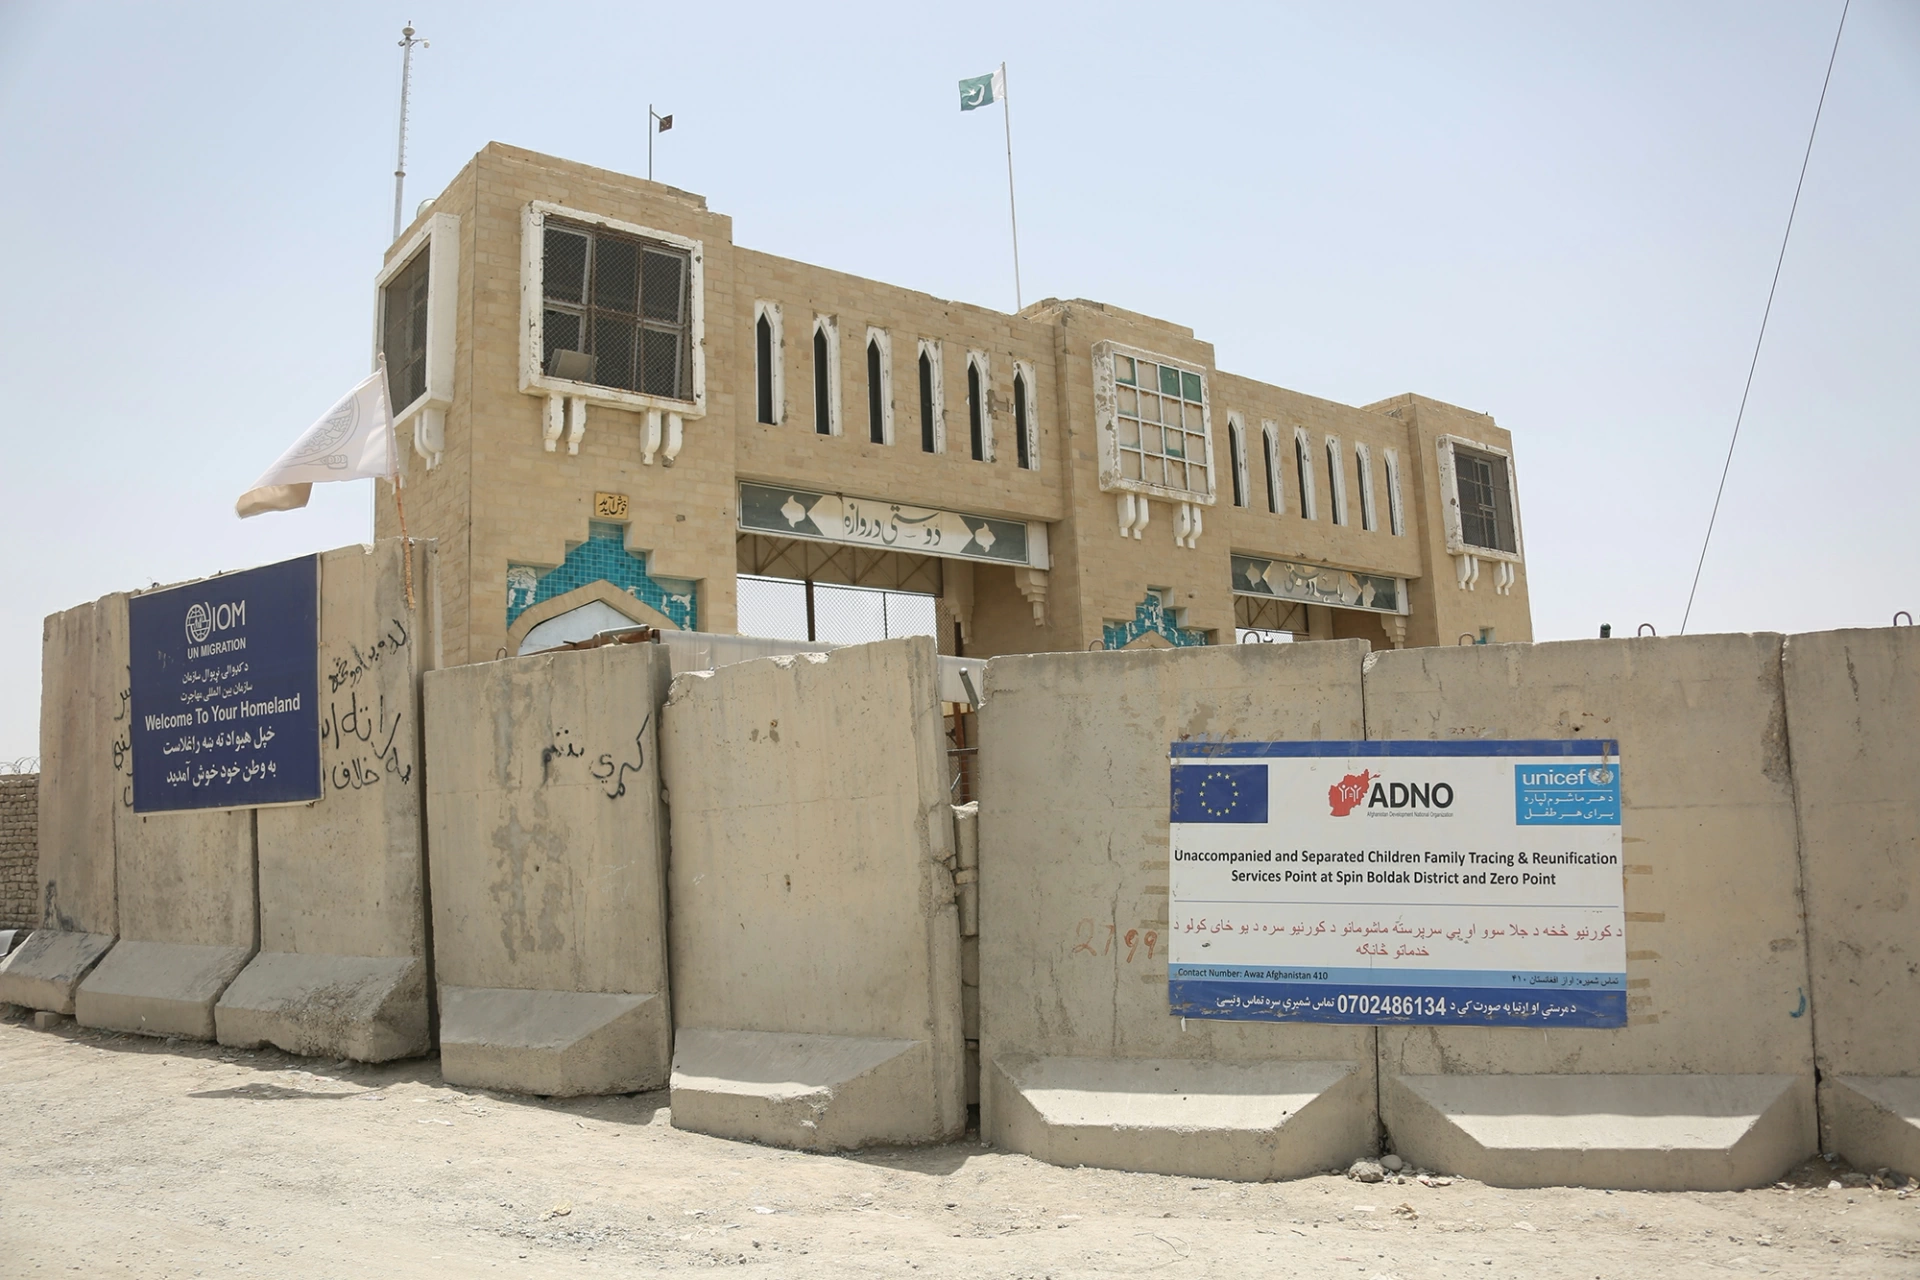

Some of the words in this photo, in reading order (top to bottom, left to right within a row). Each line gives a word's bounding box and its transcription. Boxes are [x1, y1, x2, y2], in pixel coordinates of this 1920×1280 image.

[843, 502, 881, 539] دروازه
[212, 600, 246, 632] IOM
[187, 645, 199, 660] UN
[201, 637, 247, 657] MIGRATION
[144, 712, 193, 732] Welcome
[195, 707, 210, 724] To
[211, 704, 238, 722] Your
[240, 692, 301, 719] Homeland
[215, 732, 225, 748] ته
[253, 725, 276, 750] خپل
[166, 760, 191, 787] آمدید
[192, 763, 219, 788] خوش
[220, 761, 241, 785] خود
[242, 759, 267, 783] وطن
[267, 759, 277, 778] به
[1522, 768, 1587, 786] unicef
[1367, 782, 1455, 809] ADNO
[1523, 792, 1548, 807] لپاره
[1547, 792, 1585, 807] ماشوم
[1586, 794, 1606, 805] هر
[1524, 807, 1557, 820] طفل
[1558, 809, 1583, 820] هر
[1583, 808, 1615, 820] برای
[1174, 849, 1272, 865] Unaccompanied
[1275, 850, 1299, 862] and
[1301, 850, 1364, 865] Separated
[1367, 850, 1421, 863] Children
[1424, 851, 1466, 867] Family
[1469, 851, 1515, 867] Tracing
[1518, 852, 1529, 865] &
[1532, 852, 1618, 866] Reunification
[1231, 869, 1282, 883] Services
[1284, 870, 1318, 883] Point
[1320, 871, 1333, 883] at
[1336, 870, 1364, 886] Spin
[1366, 870, 1411, 884] Boldak
[1414, 871, 1460, 885] District
[1462, 872, 1487, 885] and
[1489, 872, 1519, 885] Zero
[1522, 873, 1557, 885] Point
[1173, 920, 1180, 931] د
[1183, 917, 1207, 934] کولو
[1238, 923, 1250, 935] یو
[1252, 922, 1259, 932] د
[1262, 923, 1285, 936] سره
[1289, 920, 1326, 936] کورنیو
[1330, 923, 1337, 933] د
[1340, 921, 1389, 937] ماشومانو
[1464, 922, 1476, 939] او
[1508, 923, 1529, 939] جلا
[1533, 927, 1540, 937] د
[1542, 923, 1569, 938] څخه
[1573, 924, 1612, 941] کورنیو
[1616, 928, 1623, 938] د
[1393, 943, 1430, 959] خدماتو
[1177, 967, 1207, 977] Contact
[1208, 969, 1242, 978] Number:
[1243, 970, 1264, 979] Awaz
[1266, 970, 1311, 980] Afghanistan
[1312, 971, 1328, 980] 410
[1600, 976, 1619, 987] تماس
[1242, 995, 1265, 1009] تماس
[1264, 998, 1281, 1009] سره
[1312, 997, 1335, 1011] تماس
[1337, 994, 1447, 1016] 0702486134
[1449, 1001, 1457, 1011] د
[1473, 1002, 1501, 1015] صورت
[1502, 1002, 1512, 1016] په
[1531, 1002, 1540, 1015] او
[1570, 1004, 1578, 1013] د
